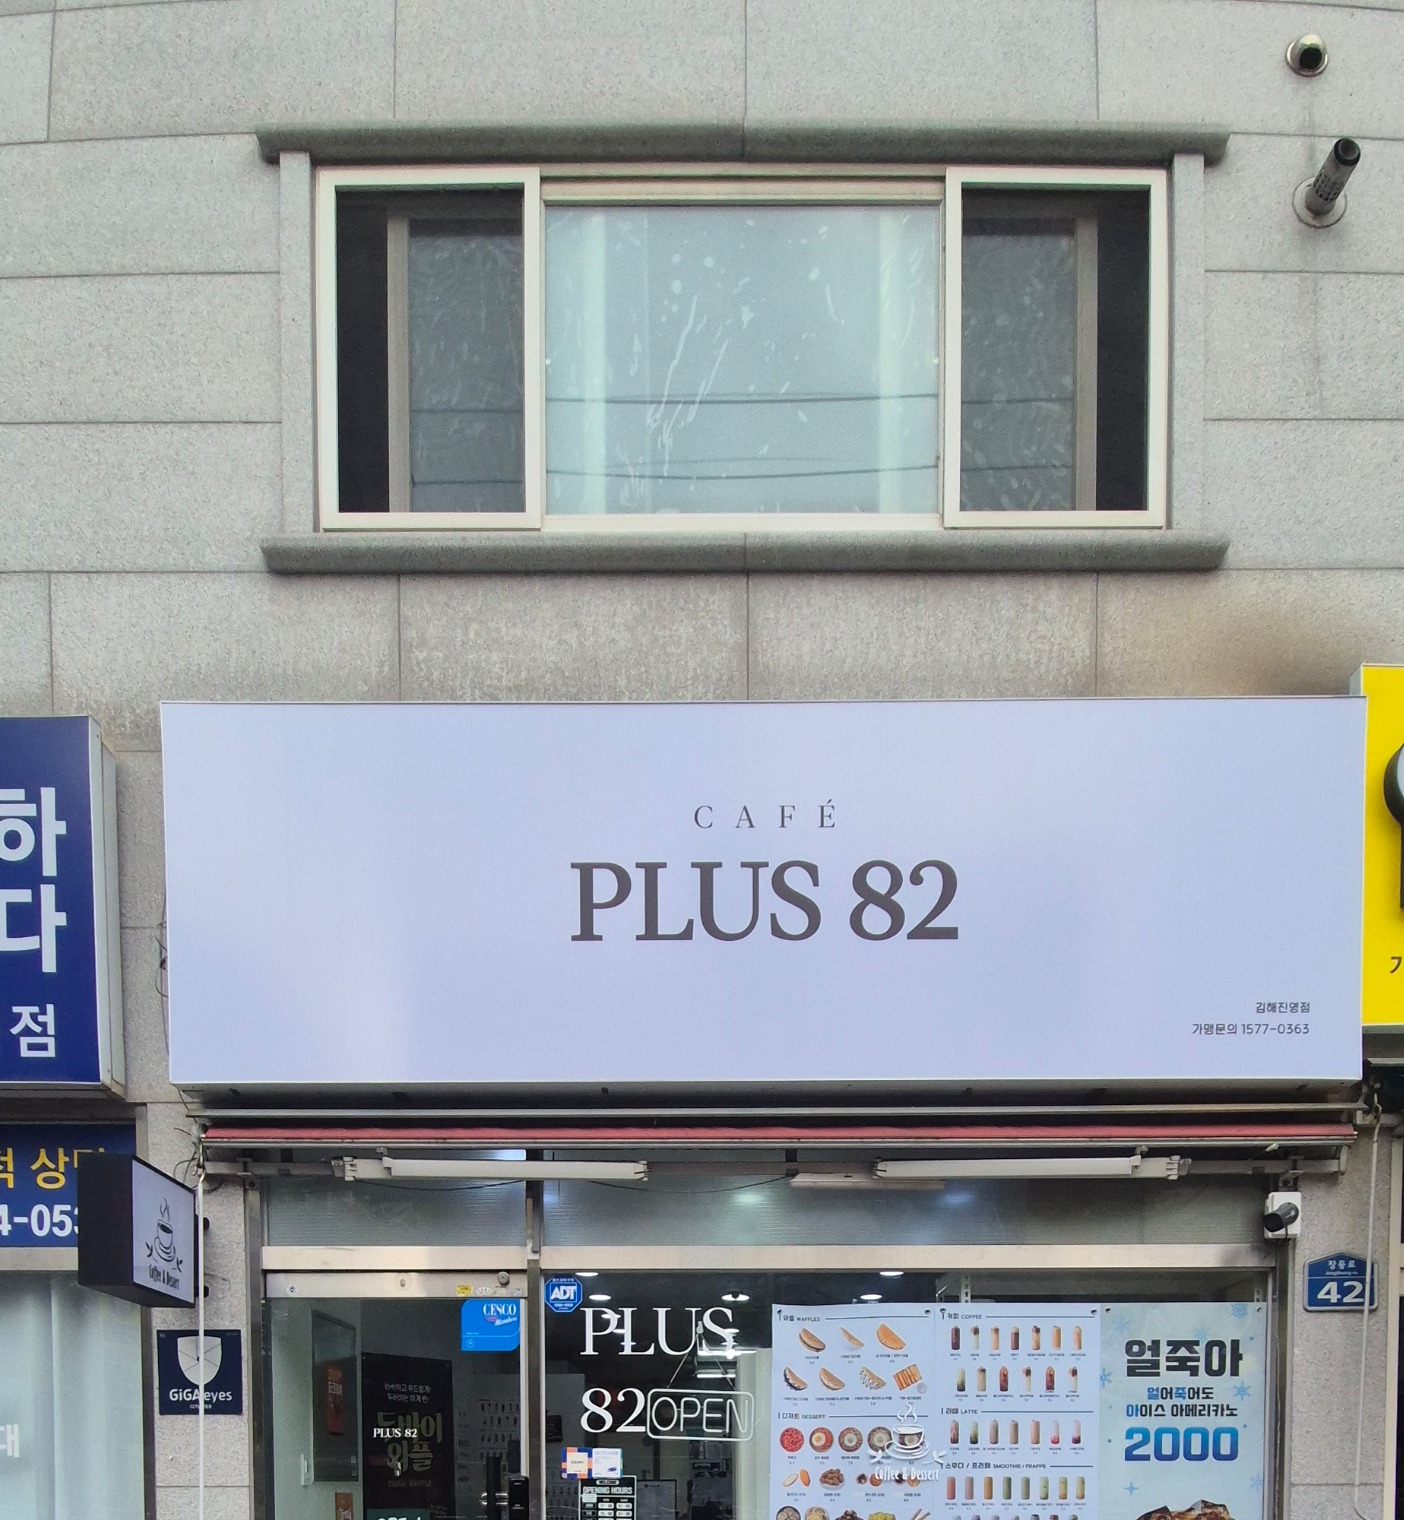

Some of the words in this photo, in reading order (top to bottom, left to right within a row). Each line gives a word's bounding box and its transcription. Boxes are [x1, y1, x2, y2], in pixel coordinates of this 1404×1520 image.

[693, 799, 836, 829] CAFÉ
[570, 860, 821, 941] PLUS
[849, 859, 959, 941] 82
[1256, 1002, 1310, 1014] 김해진영점
[1192, 1023, 1238, 1035] 가맹문의
[1241, 1024, 1310, 1035] 1577-0363
[0, 1203, 79, 1237] 4-05
[550, 1285, 577, 1300] ADT
[1317, 1281, 1364, 1303] 42
[483, 1303, 517, 1316] CESCO
[579, 1307, 734, 1356] PLUS
[1124, 1339, 1243, 1377] 얼죽아
[1147, 1386, 1215, 1400] 얼어죽어도
[580, 1388, 646, 1433] 82
[651, 1396, 748, 1434] OPEN
[1126, 1403, 1166, 1417] 아이스
[1171, 1403, 1238, 1417] 아메리카노
[373, 1428, 402, 1438] PLUS
[404, 1428, 418, 1438] 82
[1124, 1426, 1239, 1461] 2000
[874, 1466, 900, 1482] Coffee
[911, 1466, 939, 1481] Dessert
[611, 1486, 633, 1495] HOURS
